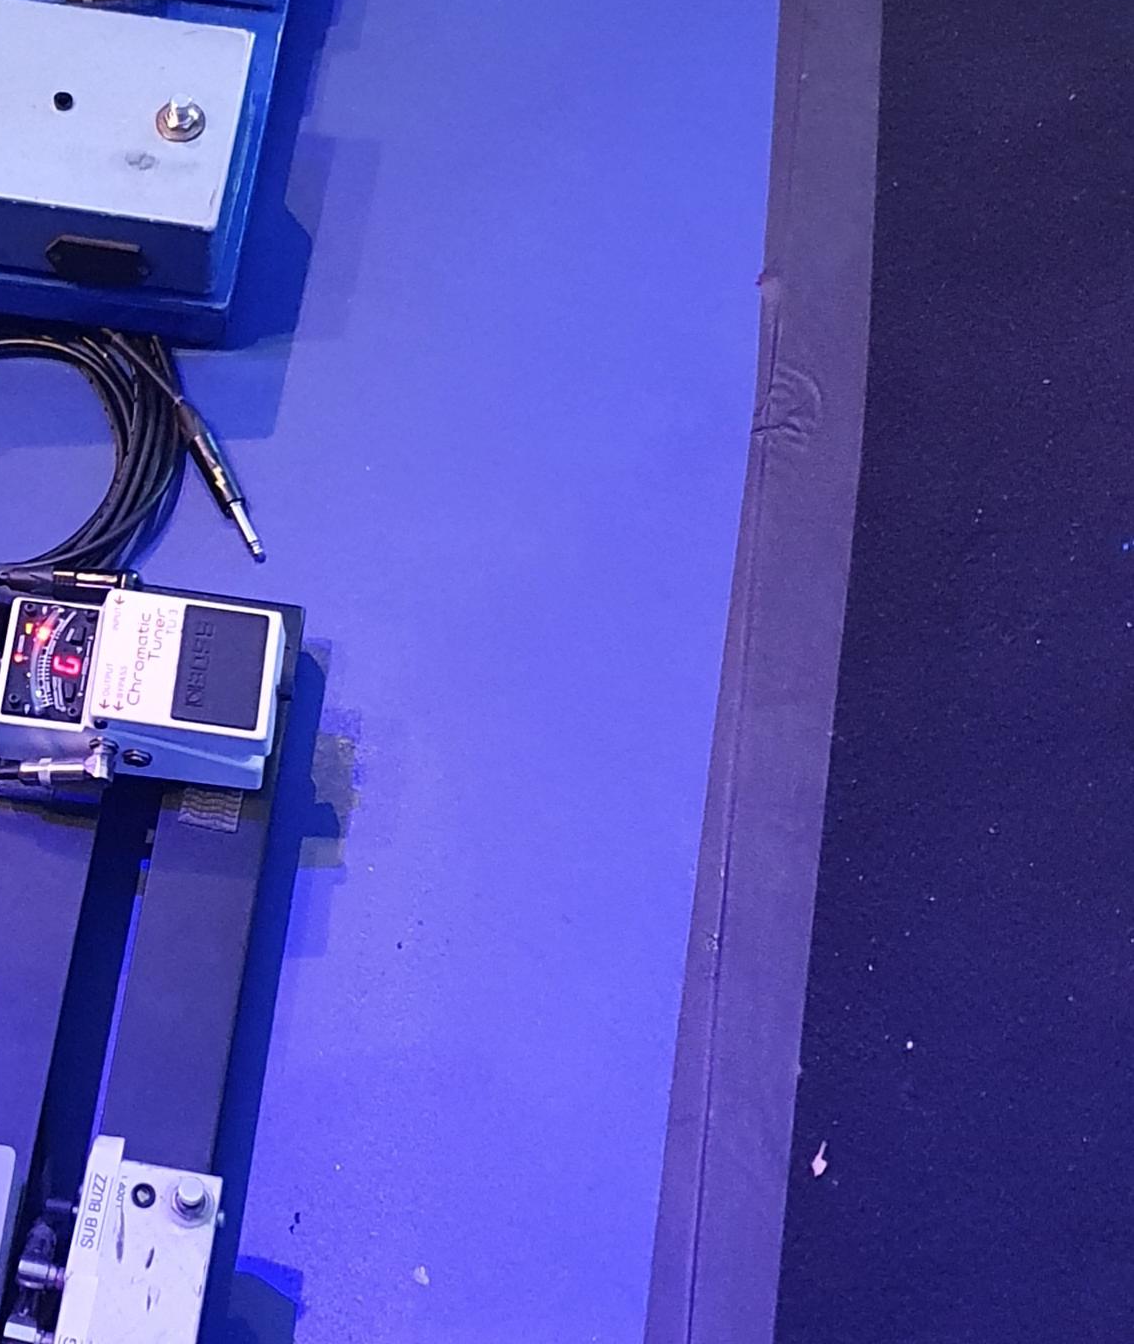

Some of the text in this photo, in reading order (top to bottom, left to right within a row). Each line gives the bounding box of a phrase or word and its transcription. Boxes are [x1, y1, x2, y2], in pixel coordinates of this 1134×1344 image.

[127, 612, 152, 706] Chromatic
[149, 608, 164, 661] Tuner
[80, 1174, 107, 1249] SUB BUZZ
